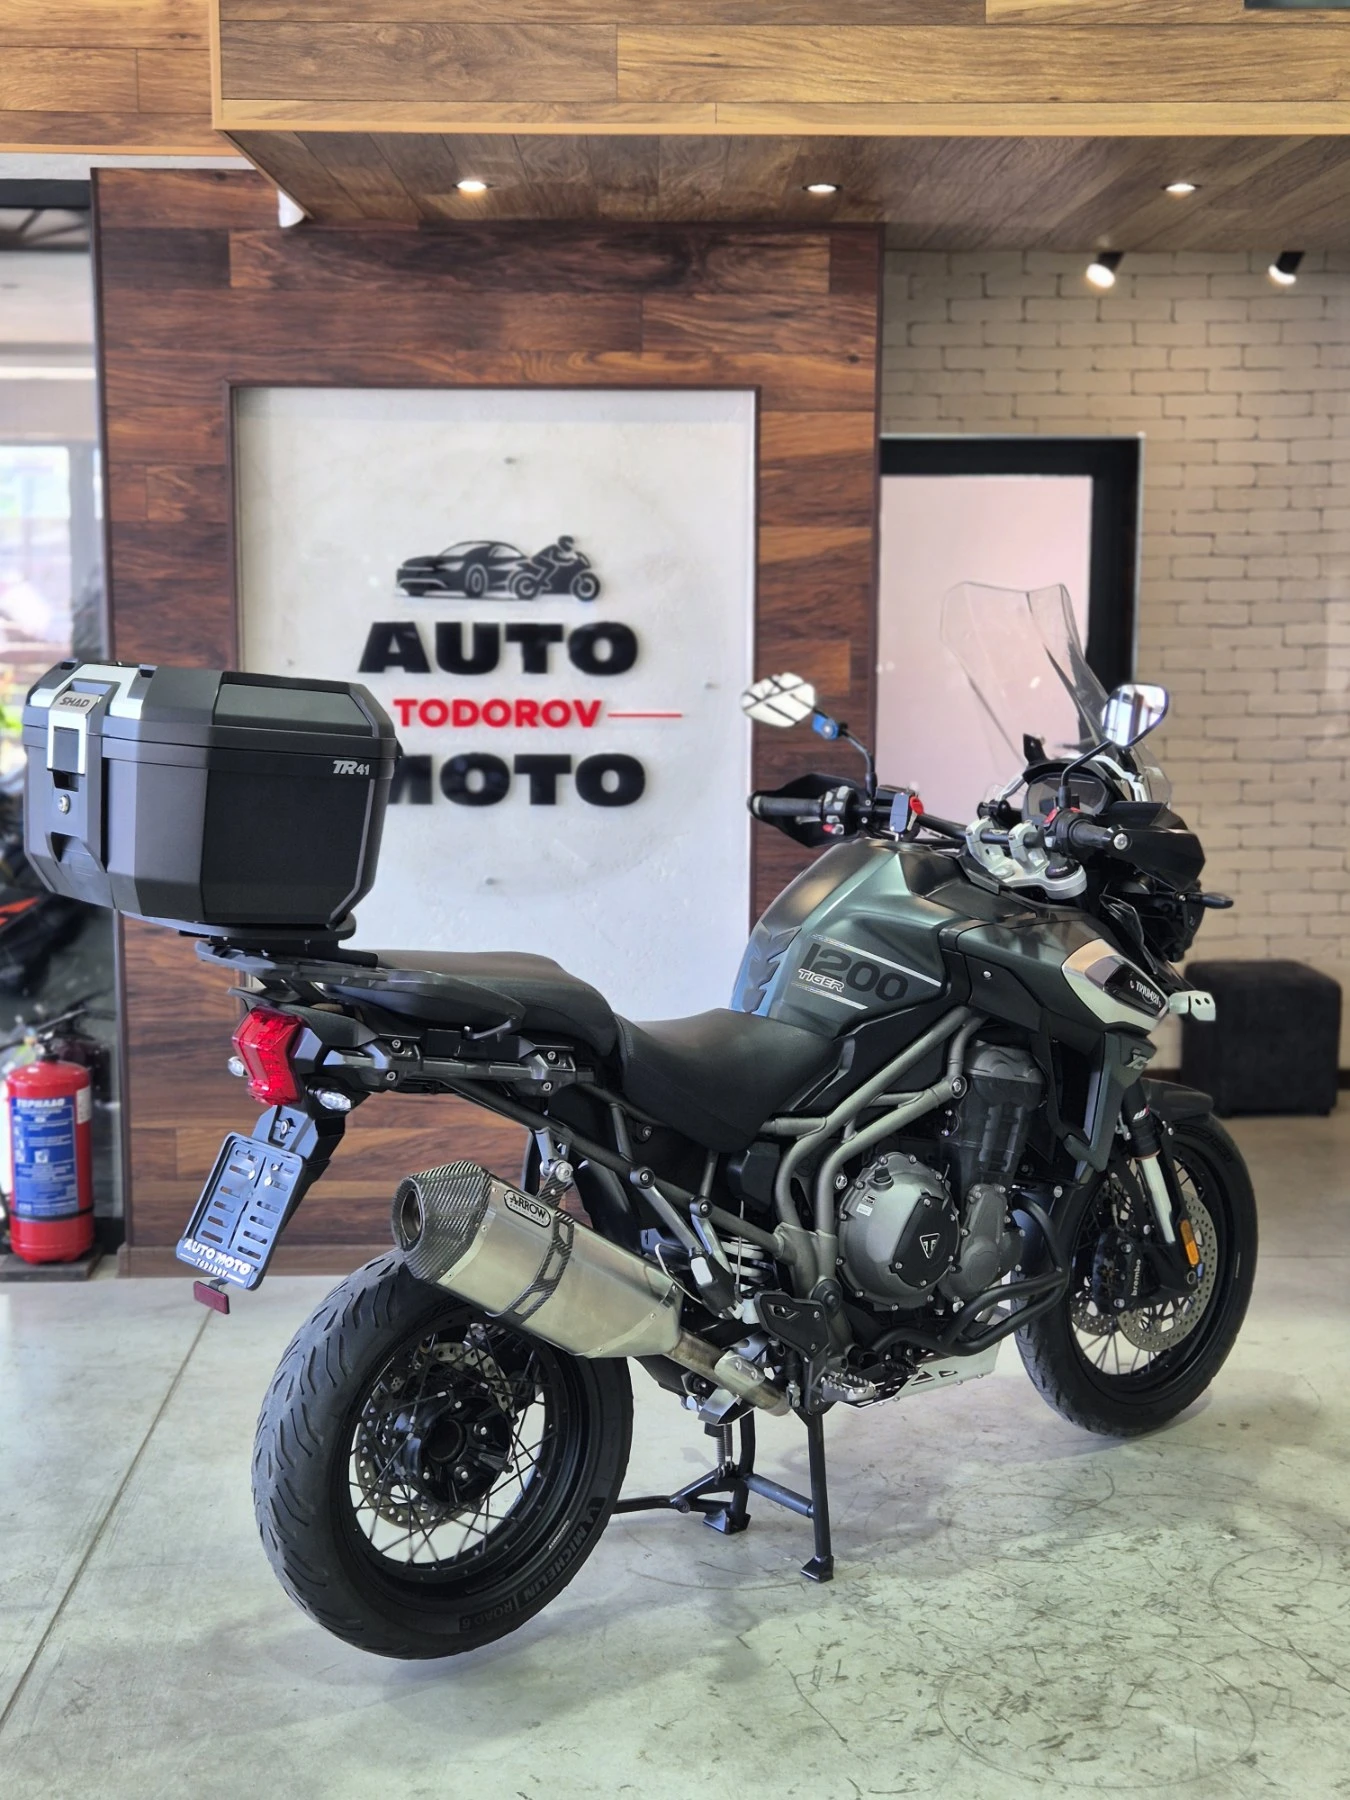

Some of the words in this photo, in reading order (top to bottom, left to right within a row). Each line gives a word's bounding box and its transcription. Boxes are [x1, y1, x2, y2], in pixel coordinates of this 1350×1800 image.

[357, 621, 639, 676] AUTO
[60, 697, 90, 708] SHAD
[393, 698, 603, 728] TODOROV
[332, 760, 370, 776] TR41
[798, 968, 846, 993] TIGER
[800, 943, 909, 1002] 1200
[510, 1194, 546, 1219] ARROW
[183, 1238, 216, 1260] AUTO
[214, 1250, 252, 1276] MOTO
[523, 1525, 588, 1601] MICHELIN
